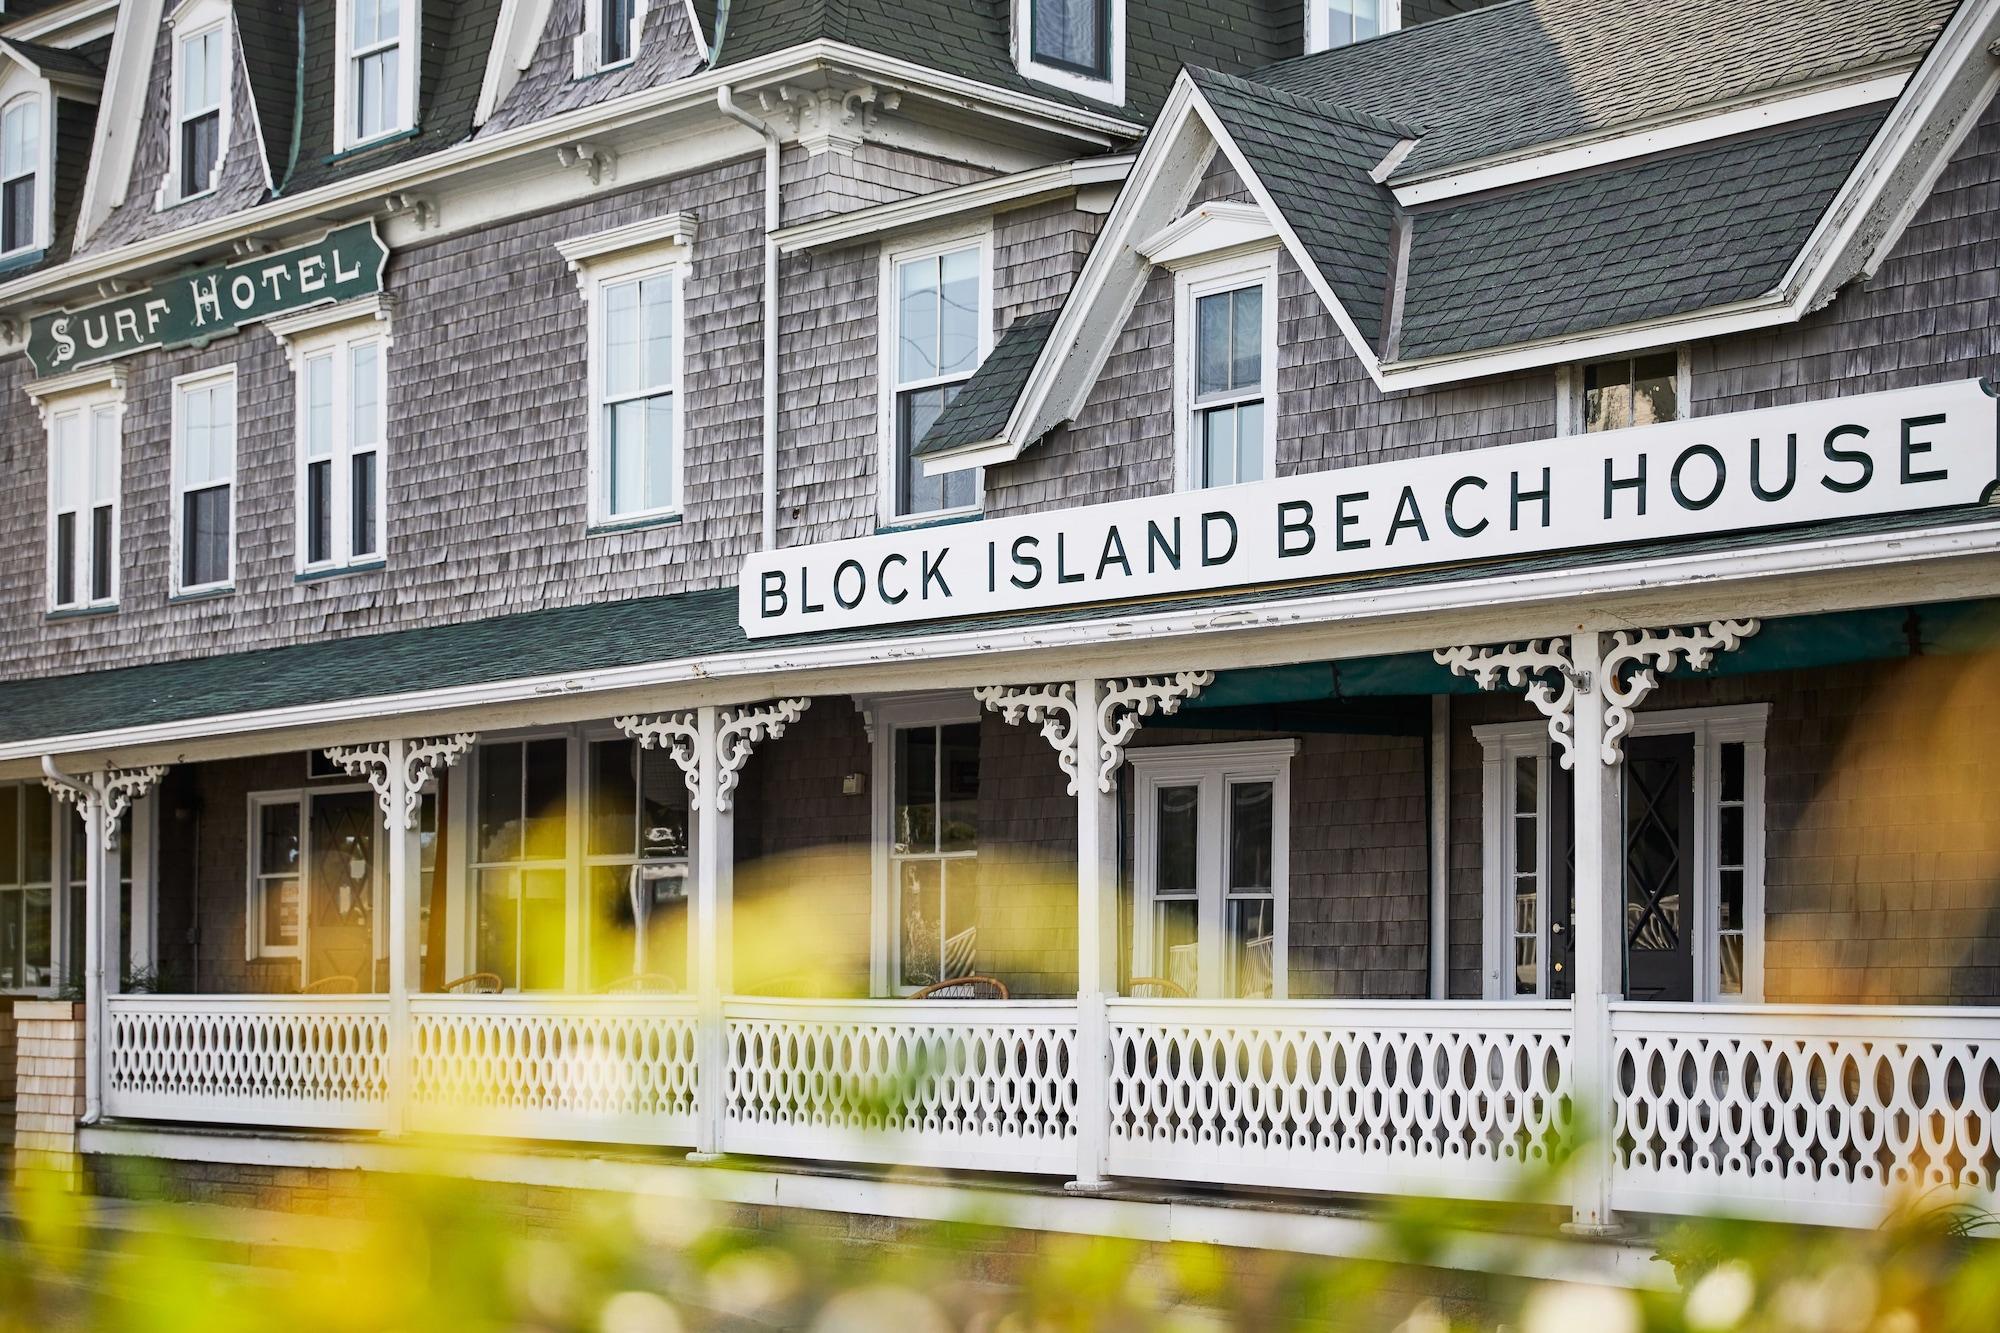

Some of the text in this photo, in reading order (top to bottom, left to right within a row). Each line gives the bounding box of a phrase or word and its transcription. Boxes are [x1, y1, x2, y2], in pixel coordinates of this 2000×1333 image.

[50, 249, 361, 367] SURF HOTEL
[761, 412, 1949, 619] BLOCK ISLAND BEACH HOUSE
